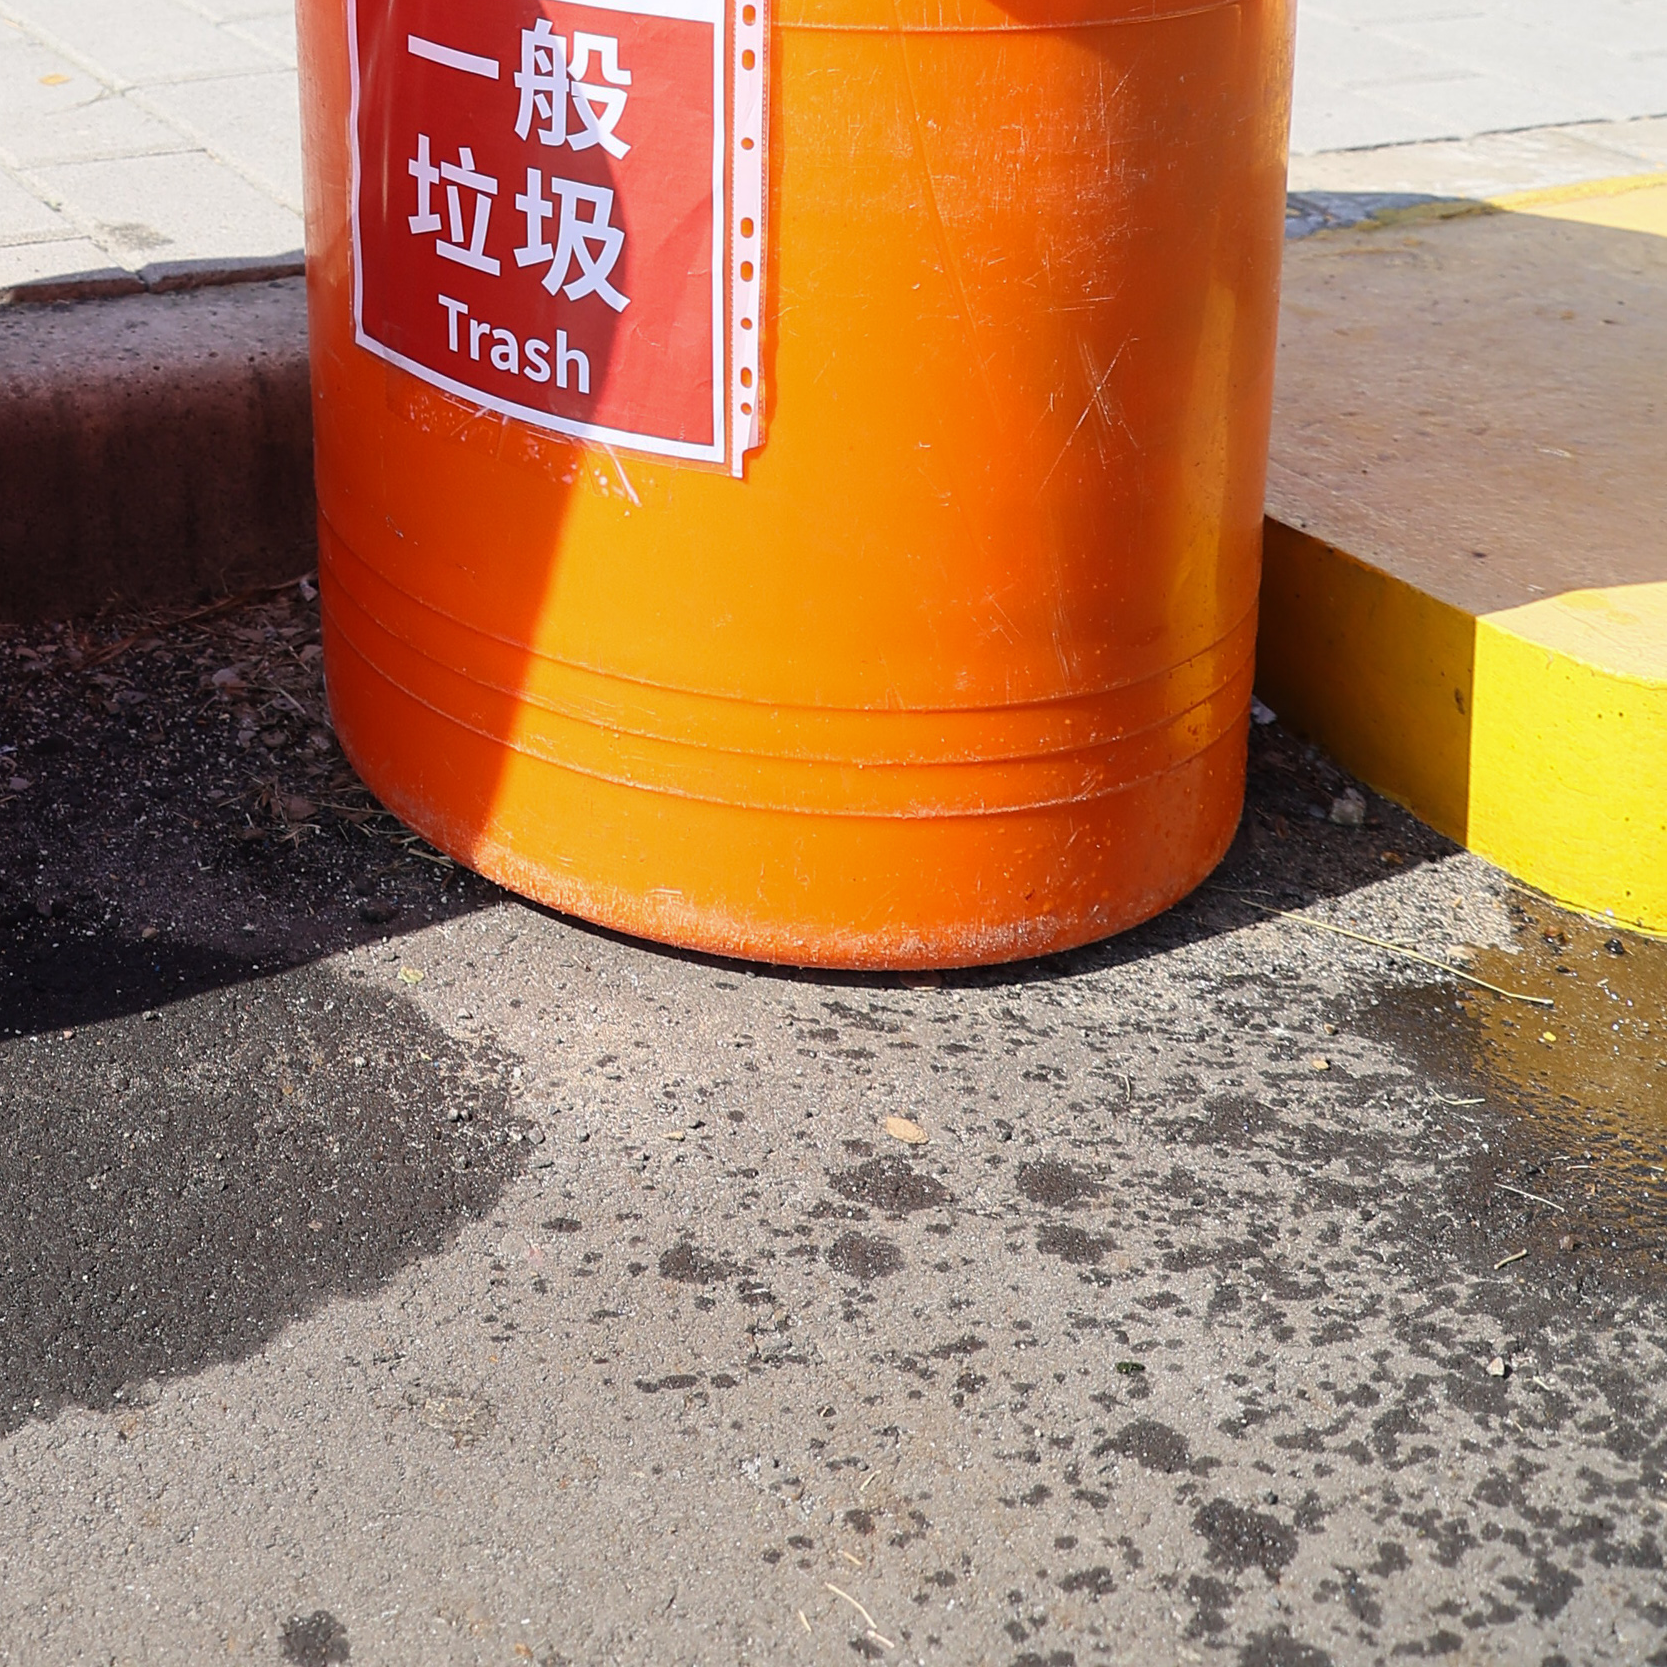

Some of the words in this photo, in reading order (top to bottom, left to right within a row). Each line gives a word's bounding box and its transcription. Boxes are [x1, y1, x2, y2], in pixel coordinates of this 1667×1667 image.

[408, 19, 631, 159] 一般
[408, 134, 630, 312] 垃圾
[439, 295, 591, 394] Trash
